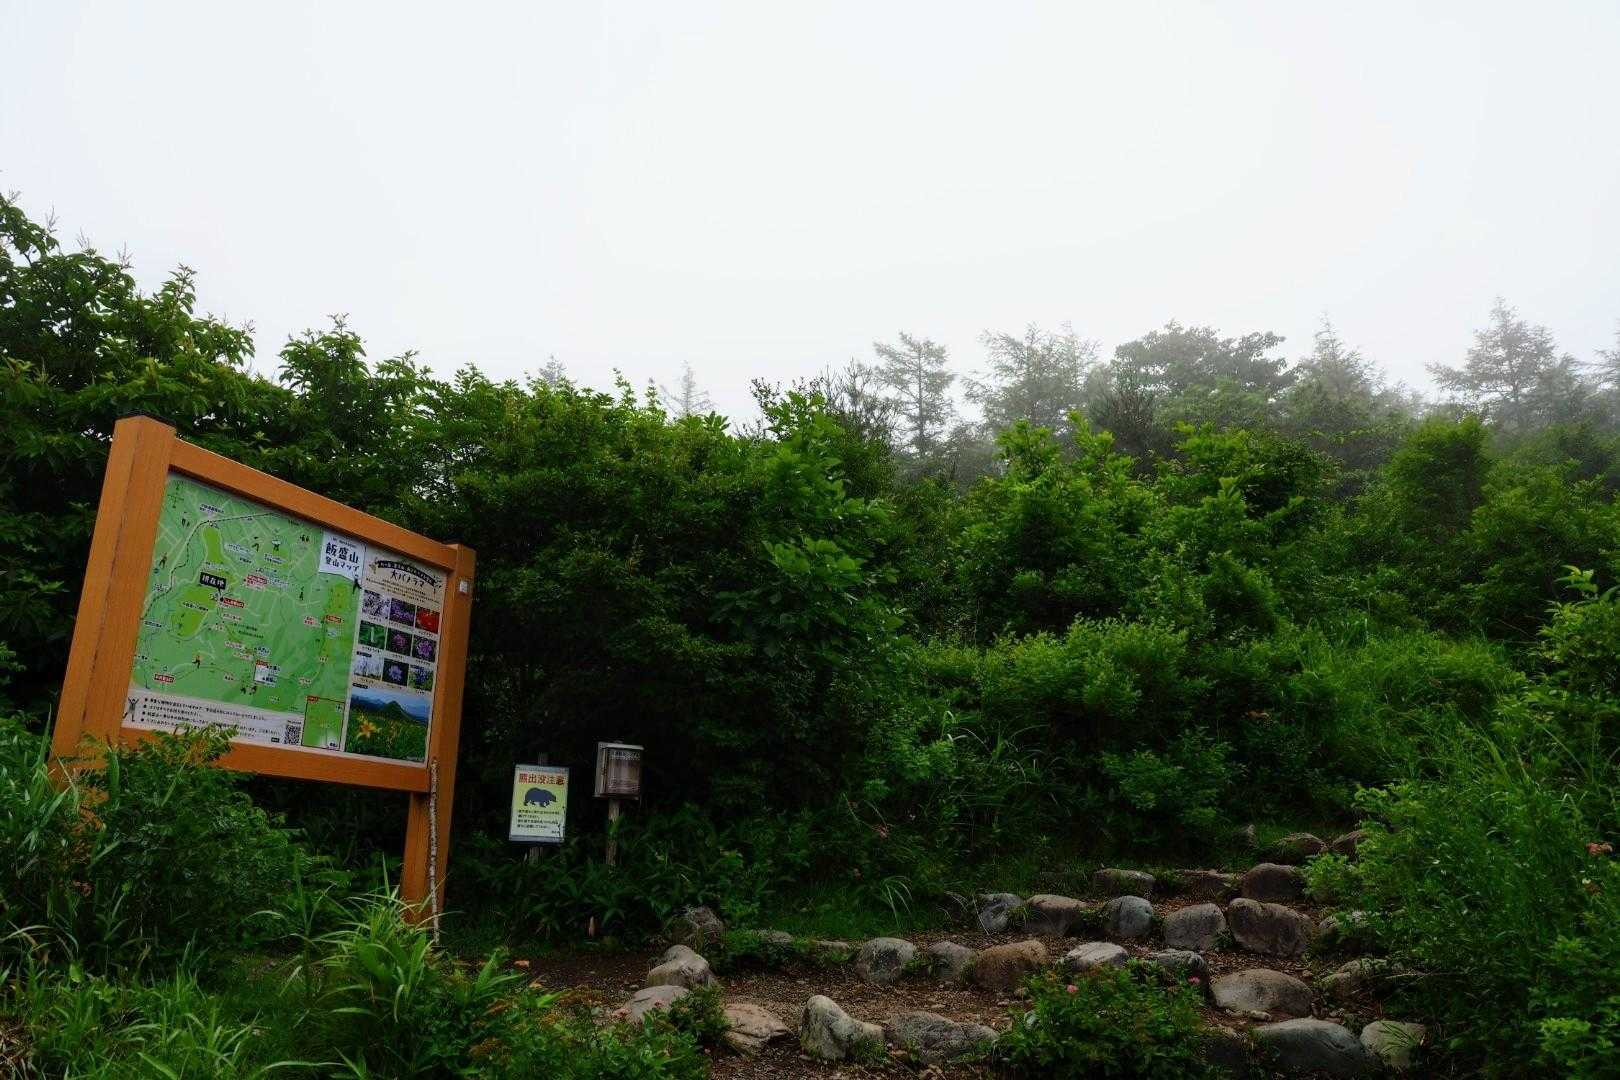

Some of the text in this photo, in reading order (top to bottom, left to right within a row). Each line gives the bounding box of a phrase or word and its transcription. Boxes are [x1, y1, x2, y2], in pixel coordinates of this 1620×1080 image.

[326, 542, 359, 564] 飯盛山
[325, 556, 360, 573] 登山マップ
[518, 773, 565, 785] 熊出没注意
